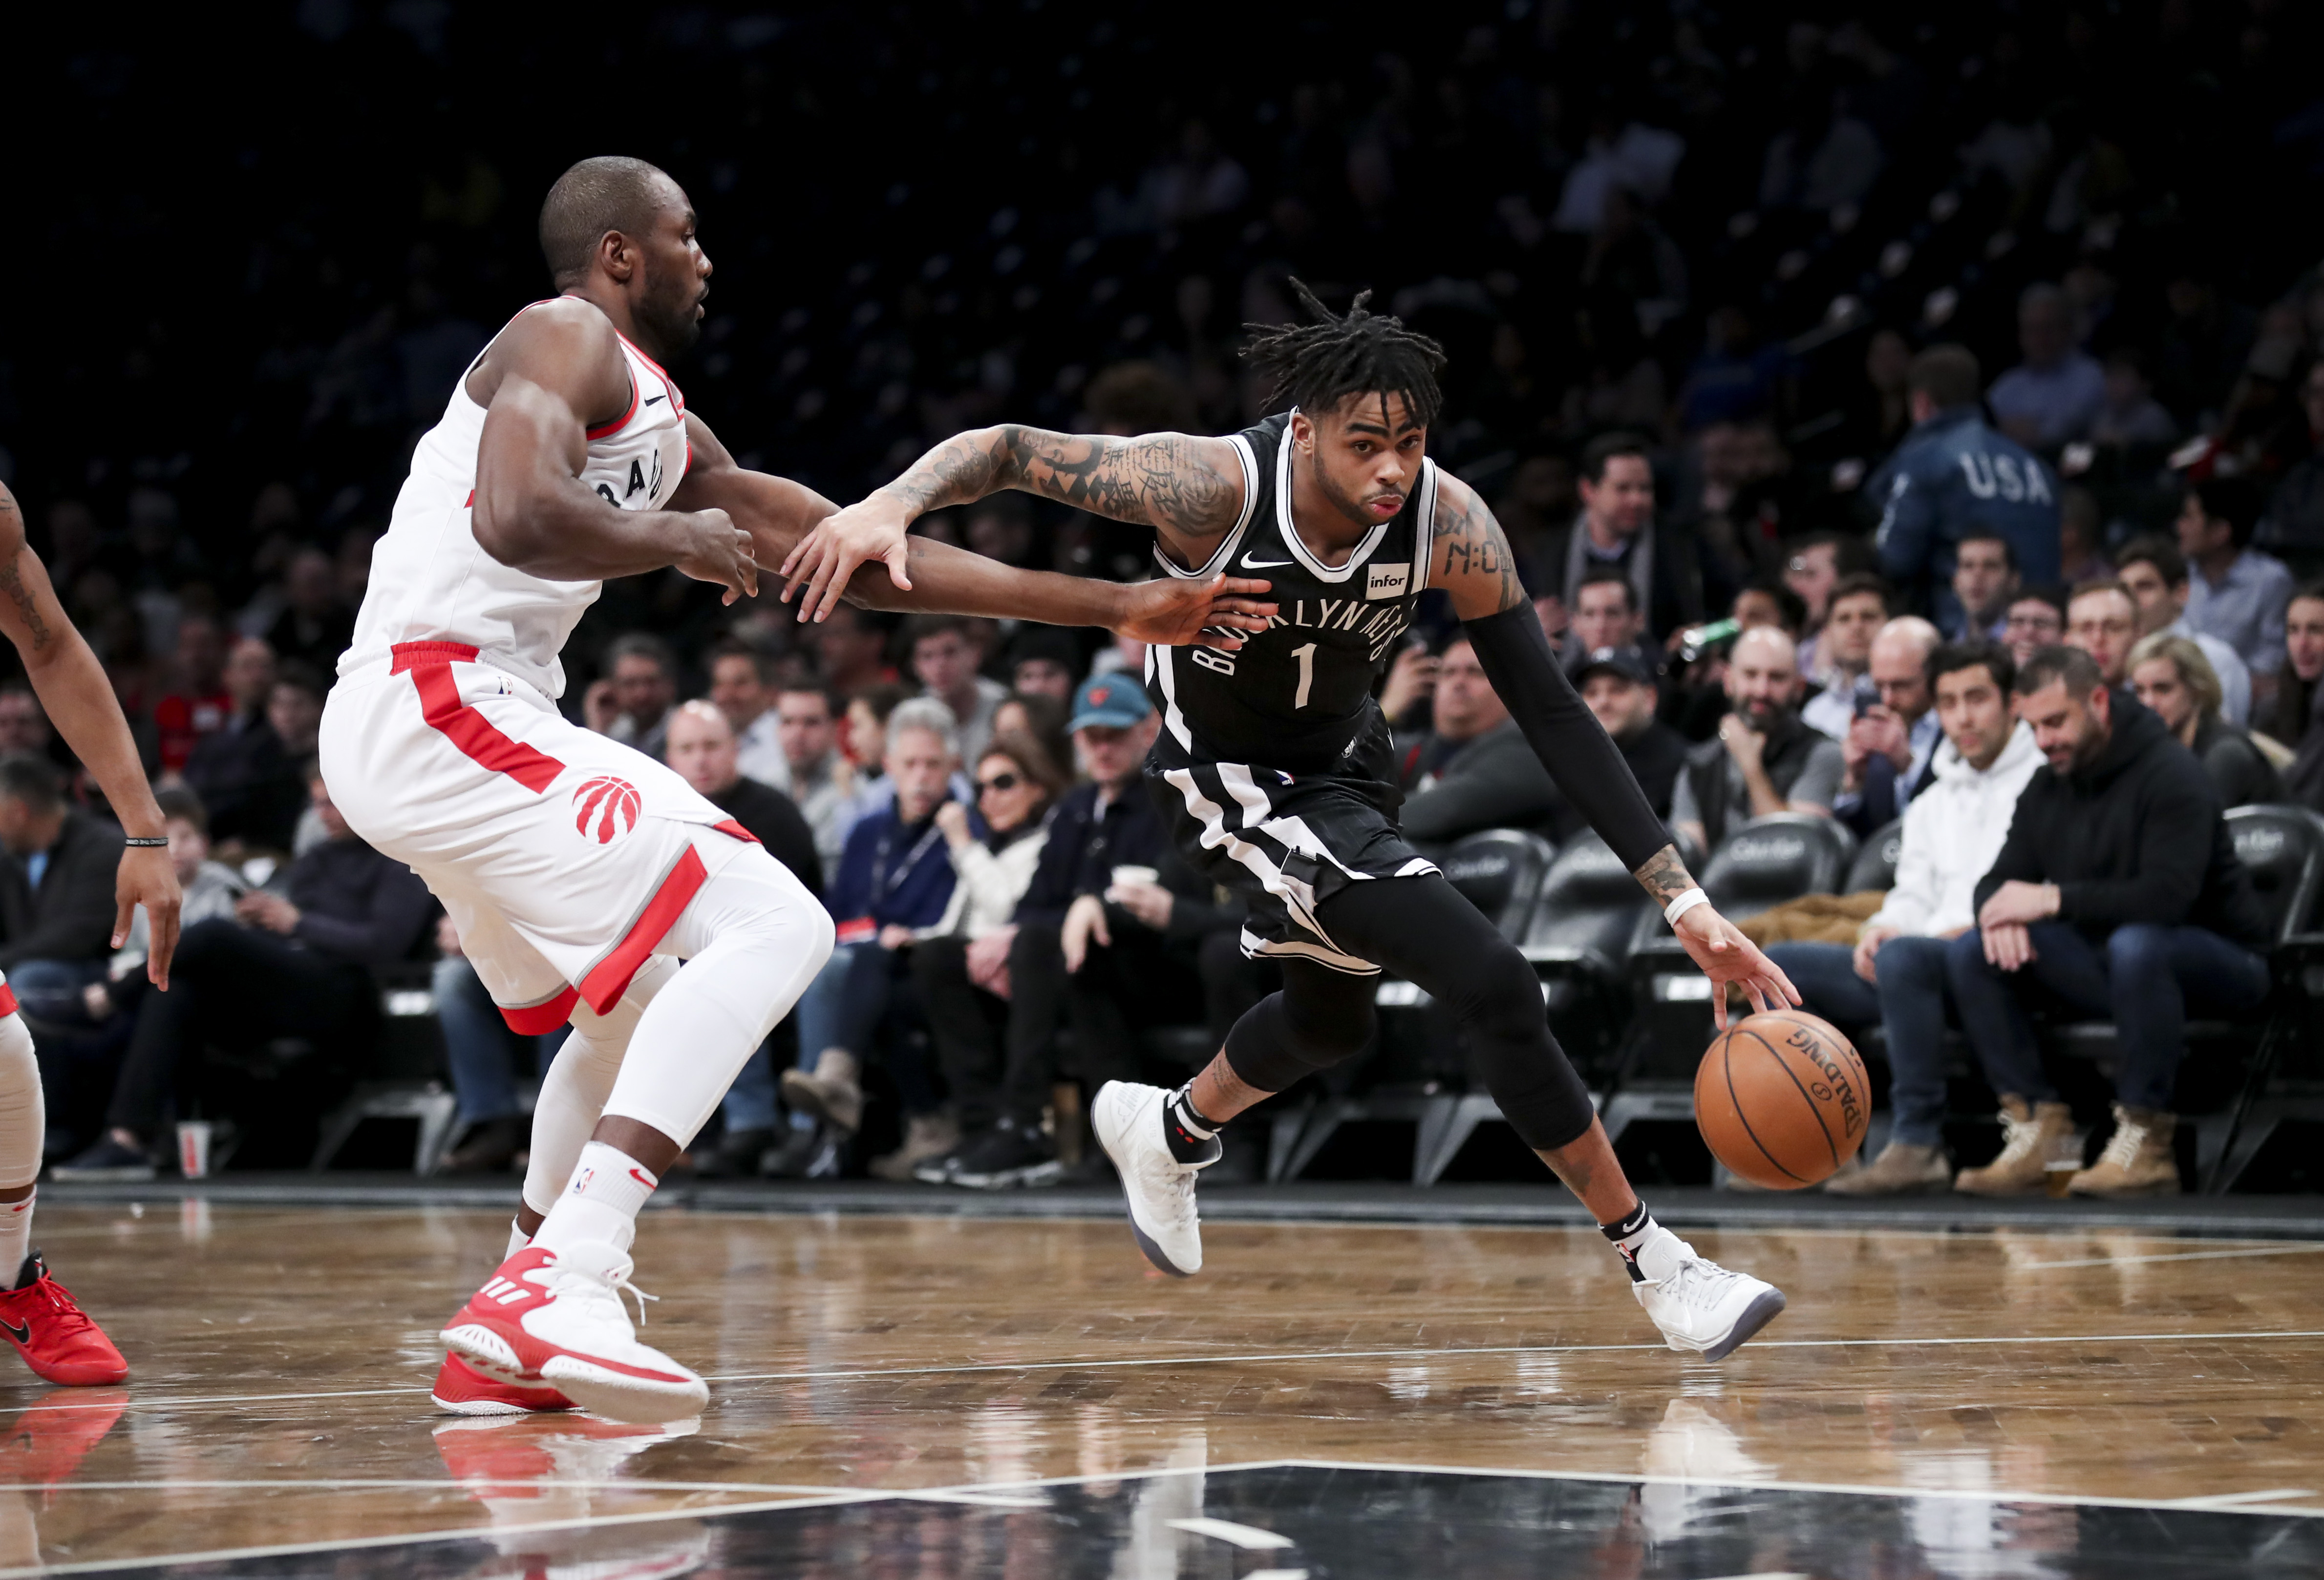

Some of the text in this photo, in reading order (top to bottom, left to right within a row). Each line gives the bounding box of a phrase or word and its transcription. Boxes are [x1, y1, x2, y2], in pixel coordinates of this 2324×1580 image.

[1958, 451, 2052, 507] USA
[1370, 575, 1405, 588] infor
[1291, 642, 1317, 710] 1
[1786, 1028, 1862, 1139] SPALDING
